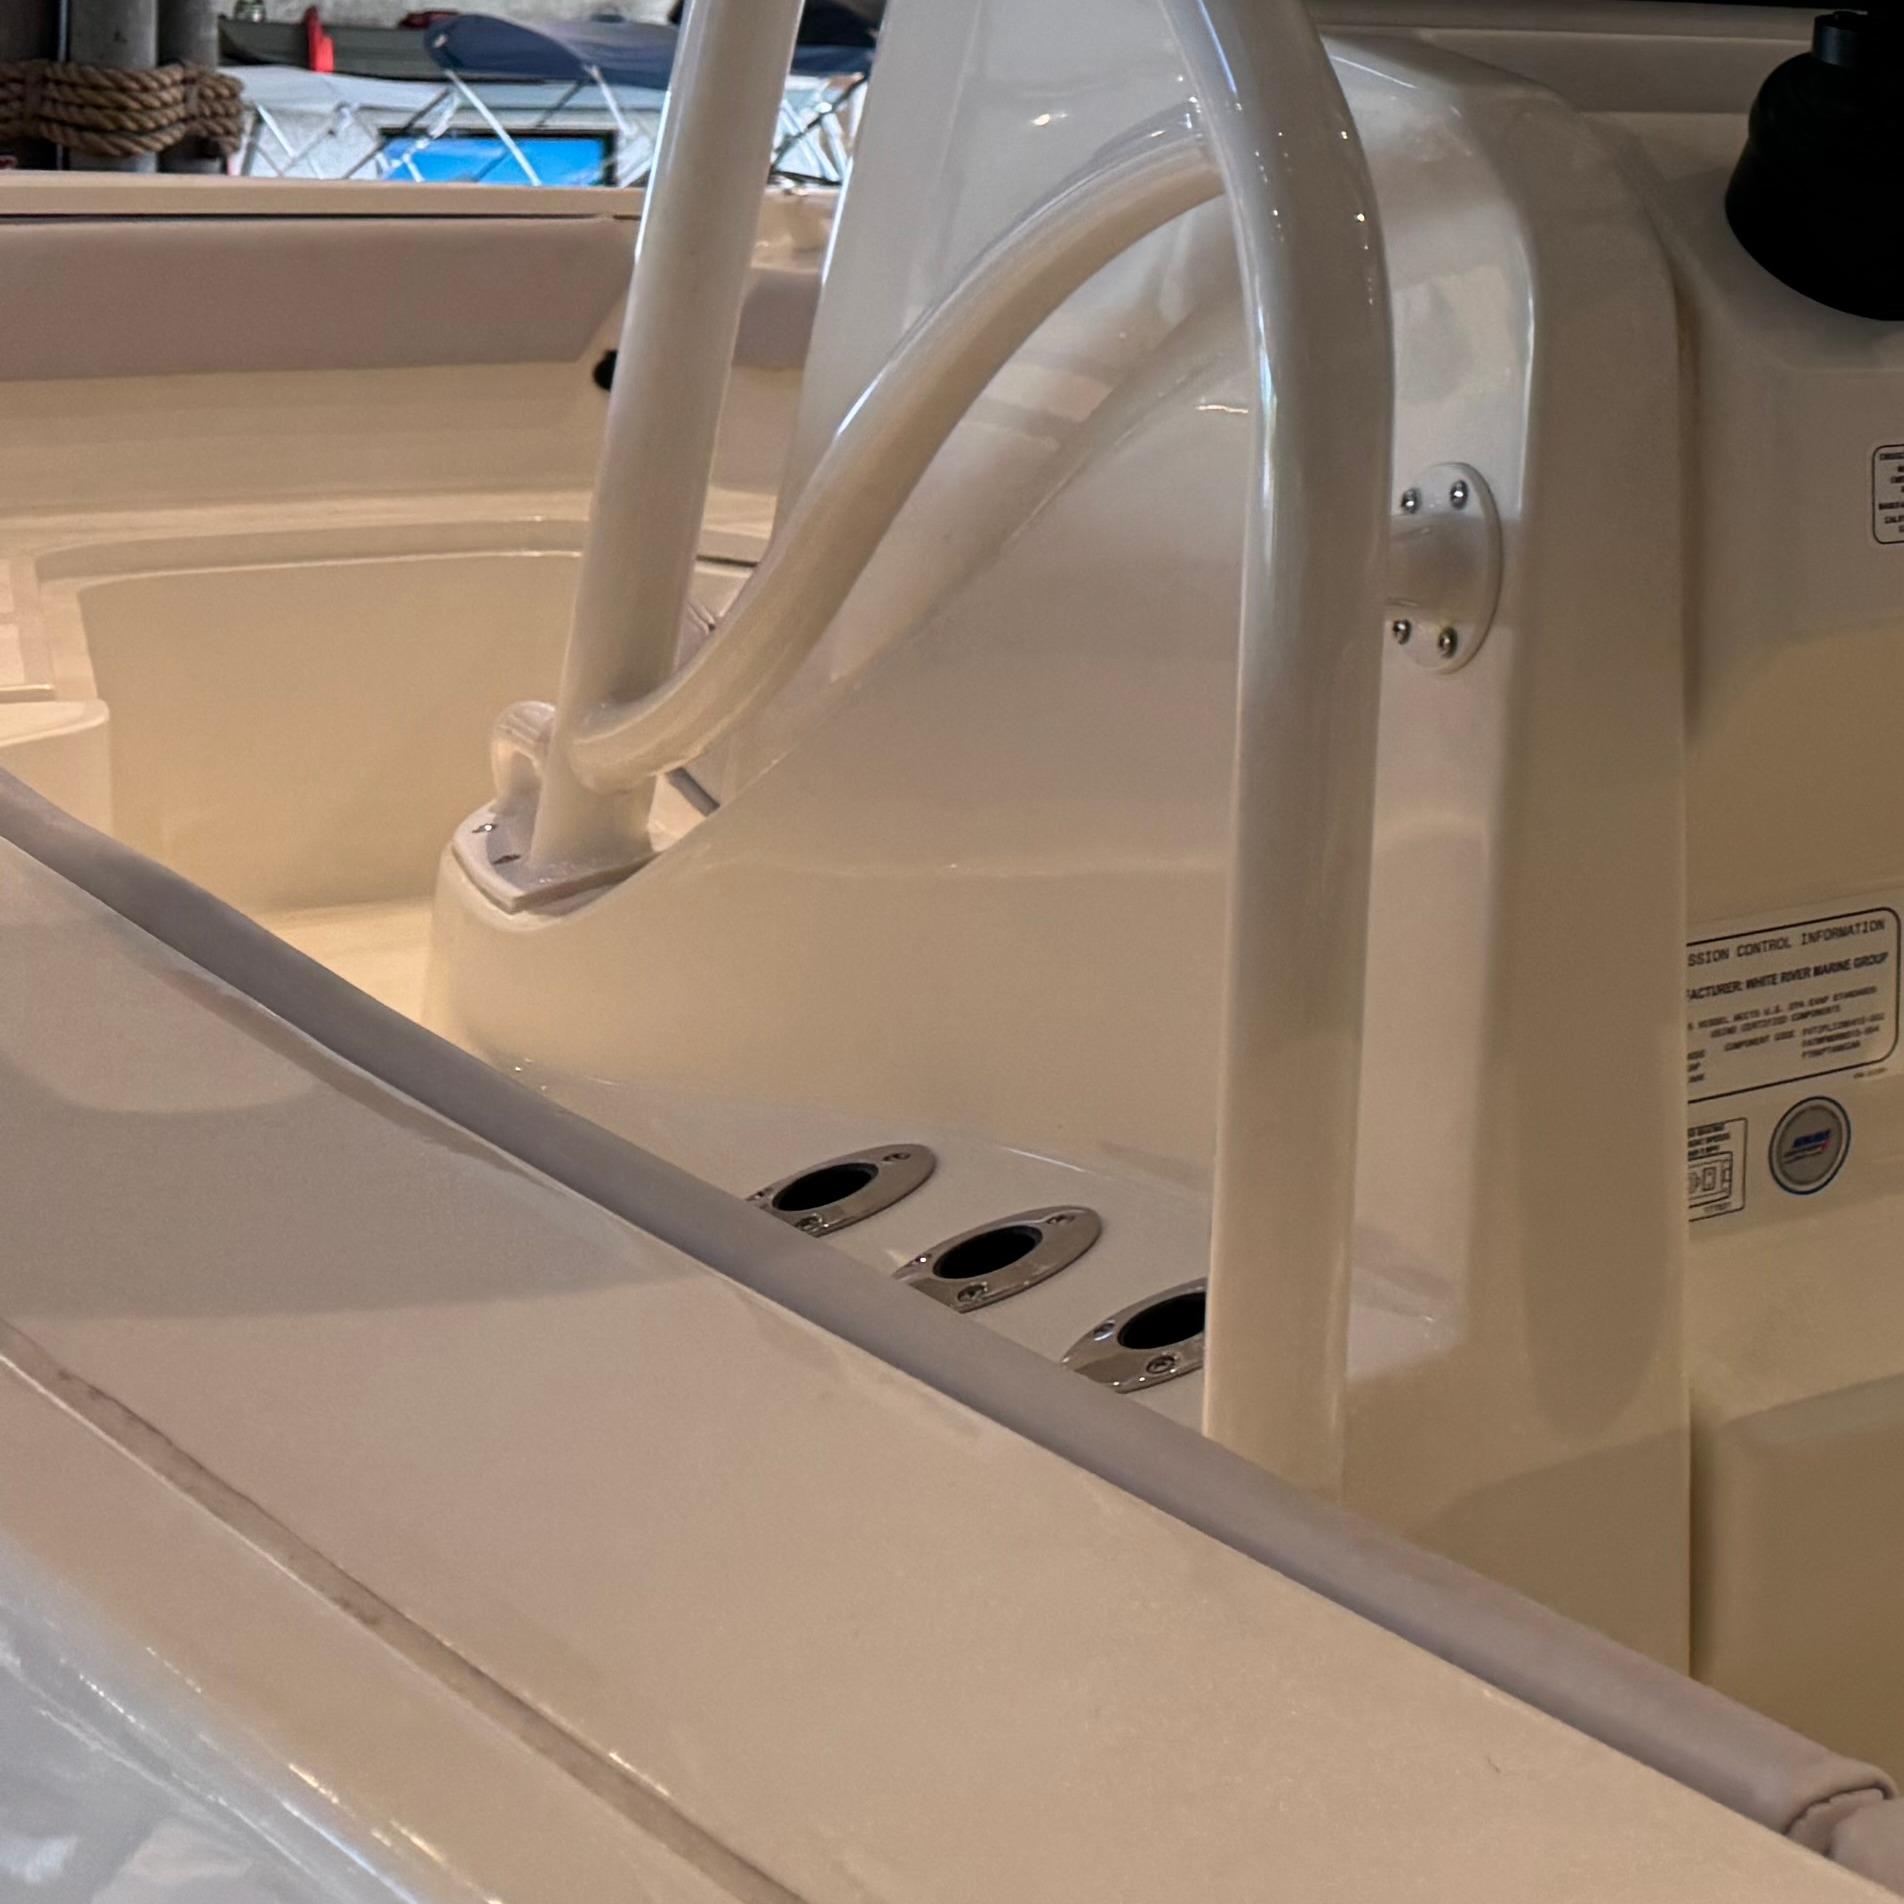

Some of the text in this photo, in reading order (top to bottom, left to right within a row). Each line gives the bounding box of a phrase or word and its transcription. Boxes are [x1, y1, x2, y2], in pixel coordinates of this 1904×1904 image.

[1736, 937, 1792, 957] CONTROL
[1801, 918, 1886, 946] INFORMATION
[1687, 951, 1889, 1001] ACTURER: WHITE RIVER MARINE GROUP
